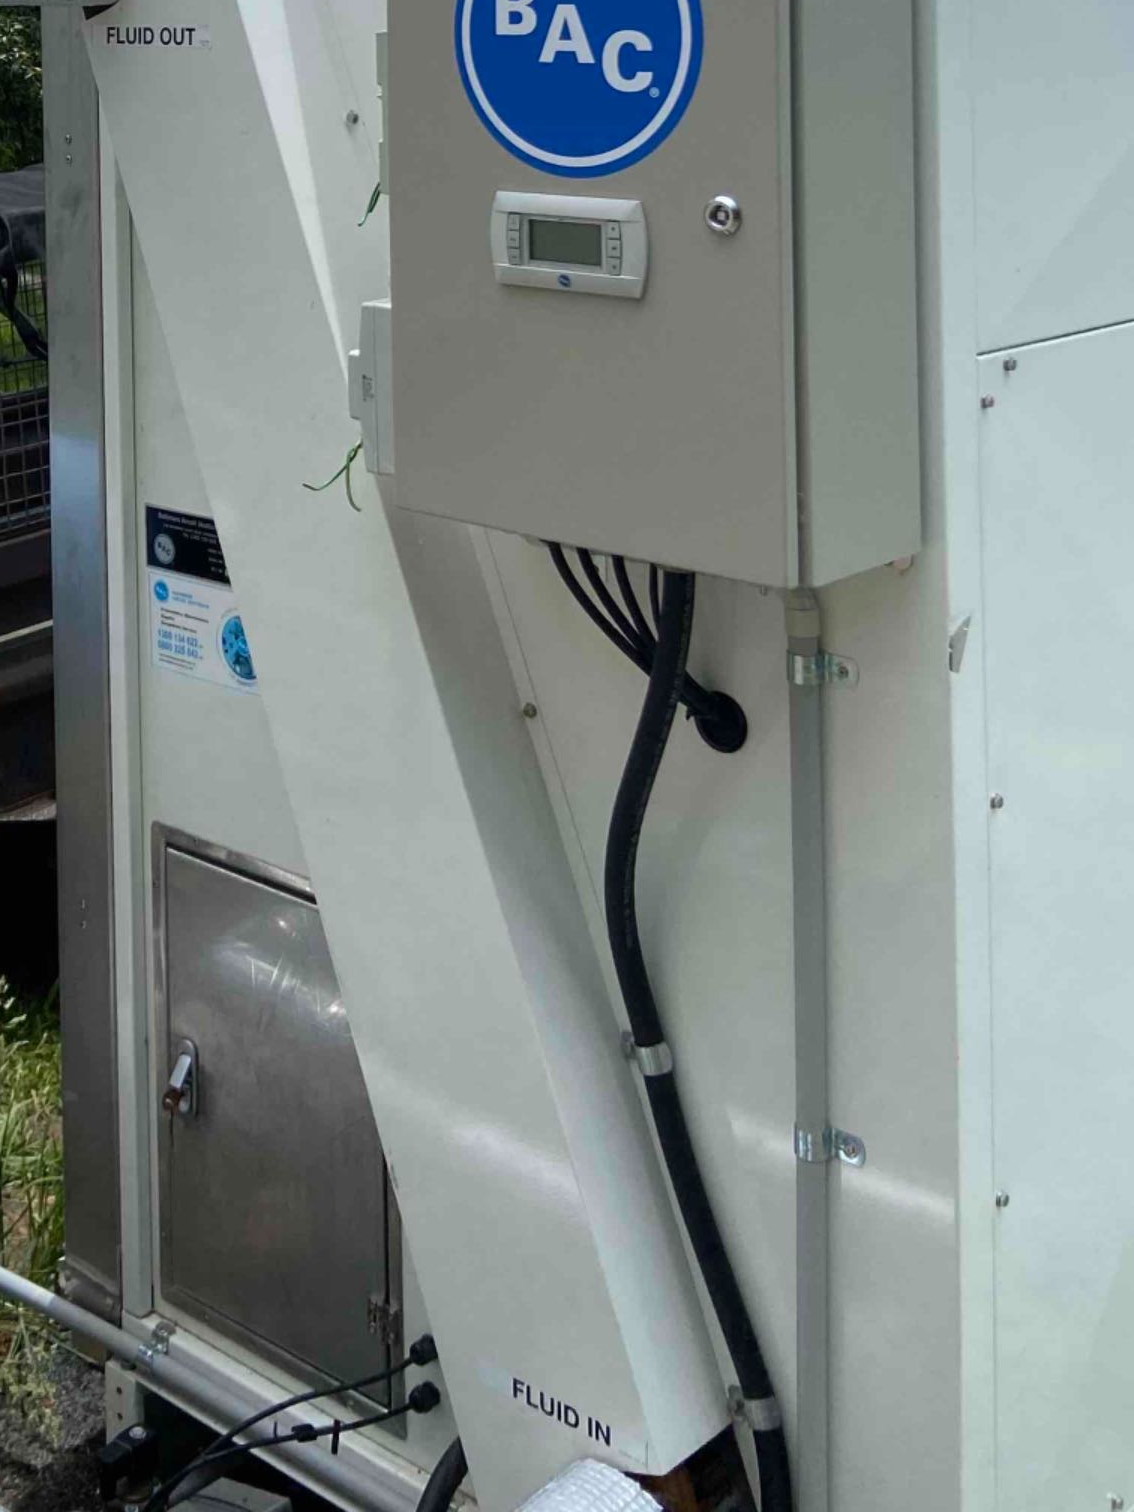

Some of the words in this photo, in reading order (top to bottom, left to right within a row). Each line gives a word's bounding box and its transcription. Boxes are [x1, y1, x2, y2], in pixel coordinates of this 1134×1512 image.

[107, 26, 155, 45] FLUID
[160, 26, 196, 46] OUT
[512, 1377, 580, 1429] FLUID
[587, 1416, 612, 1448] IN
